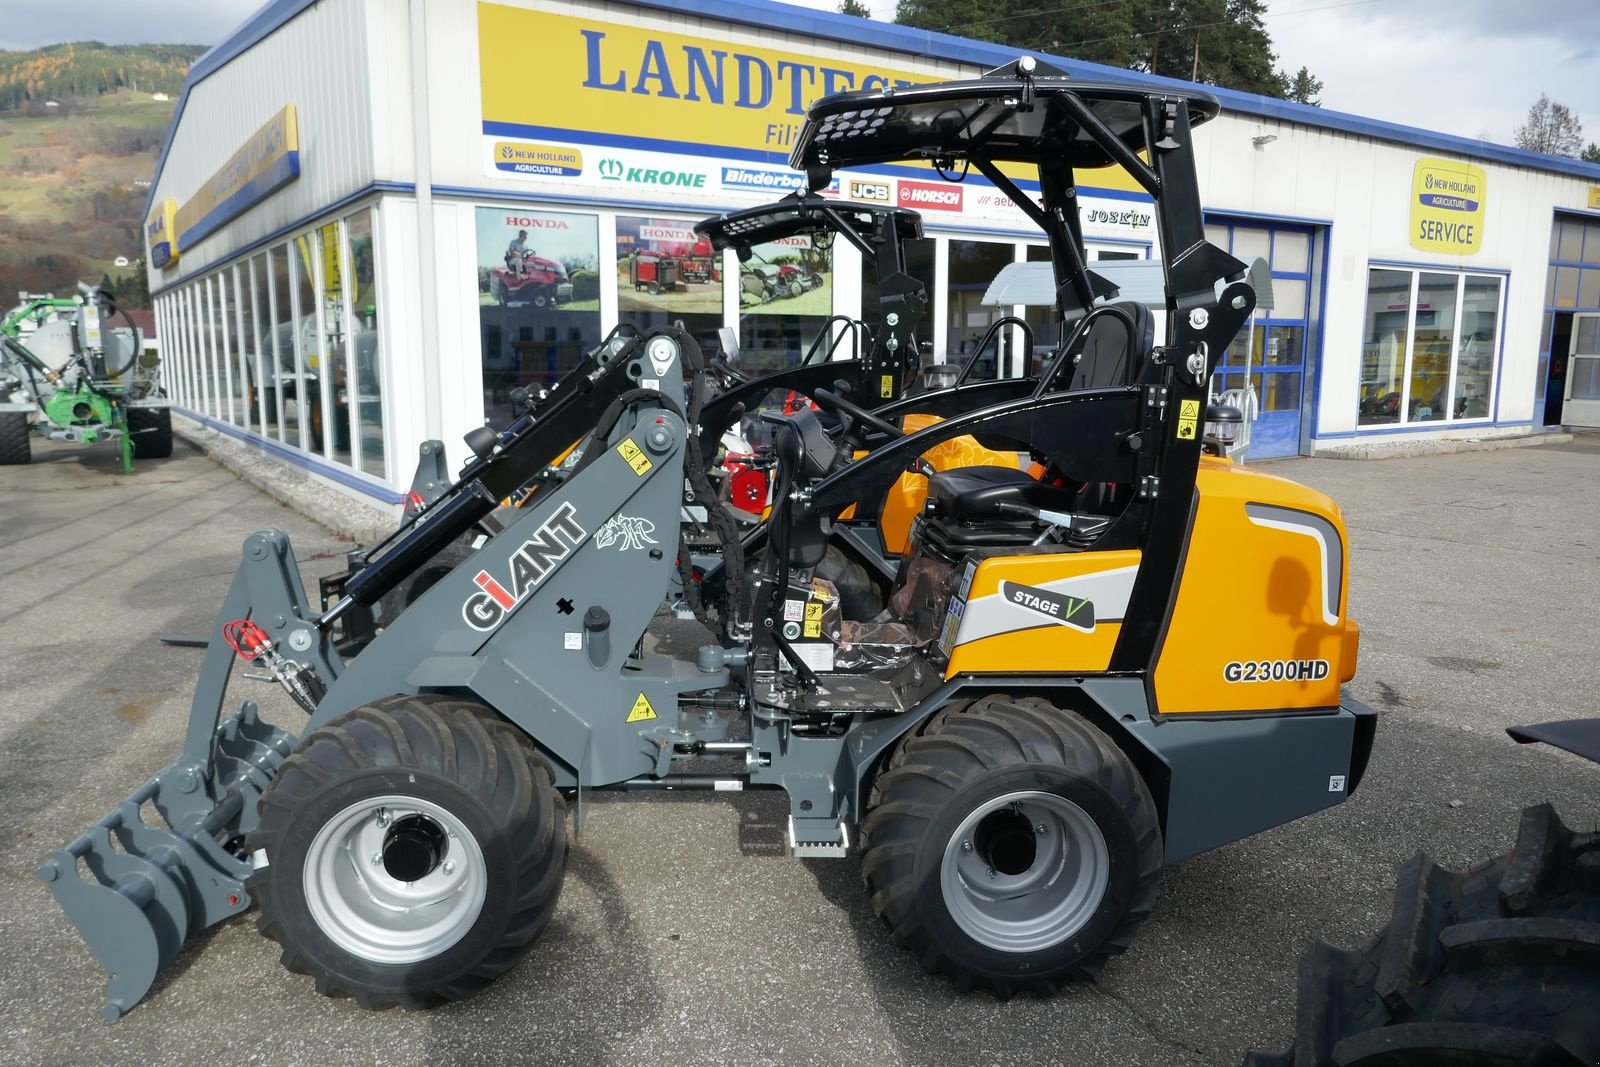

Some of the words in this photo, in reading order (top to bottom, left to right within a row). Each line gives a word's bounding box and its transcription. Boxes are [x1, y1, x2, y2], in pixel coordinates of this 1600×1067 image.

[515, 150, 534, 159] NEW
[537, 152, 576, 163] HOLLAND
[514, 164, 563, 175] AGRICULTURE
[626, 167, 707, 188] KRONE
[851, 183, 889, 200] JCB
[1434, 179, 1448, 190] NEW
[1449, 181, 1476, 194] HOLLAND
[911, 189, 960, 205] HORSCH
[1432, 196, 1467, 209] AGRICULTURE
[505, 216, 569, 230] HONDA
[1088, 209, 1151, 228] JOSKIN
[643, 228, 695, 240] HONDA
[1419, 219, 1474, 245] SERVICE
[1013, 590, 1060, 615] STAGE
[1223, 659, 1330, 684] G2300HD
